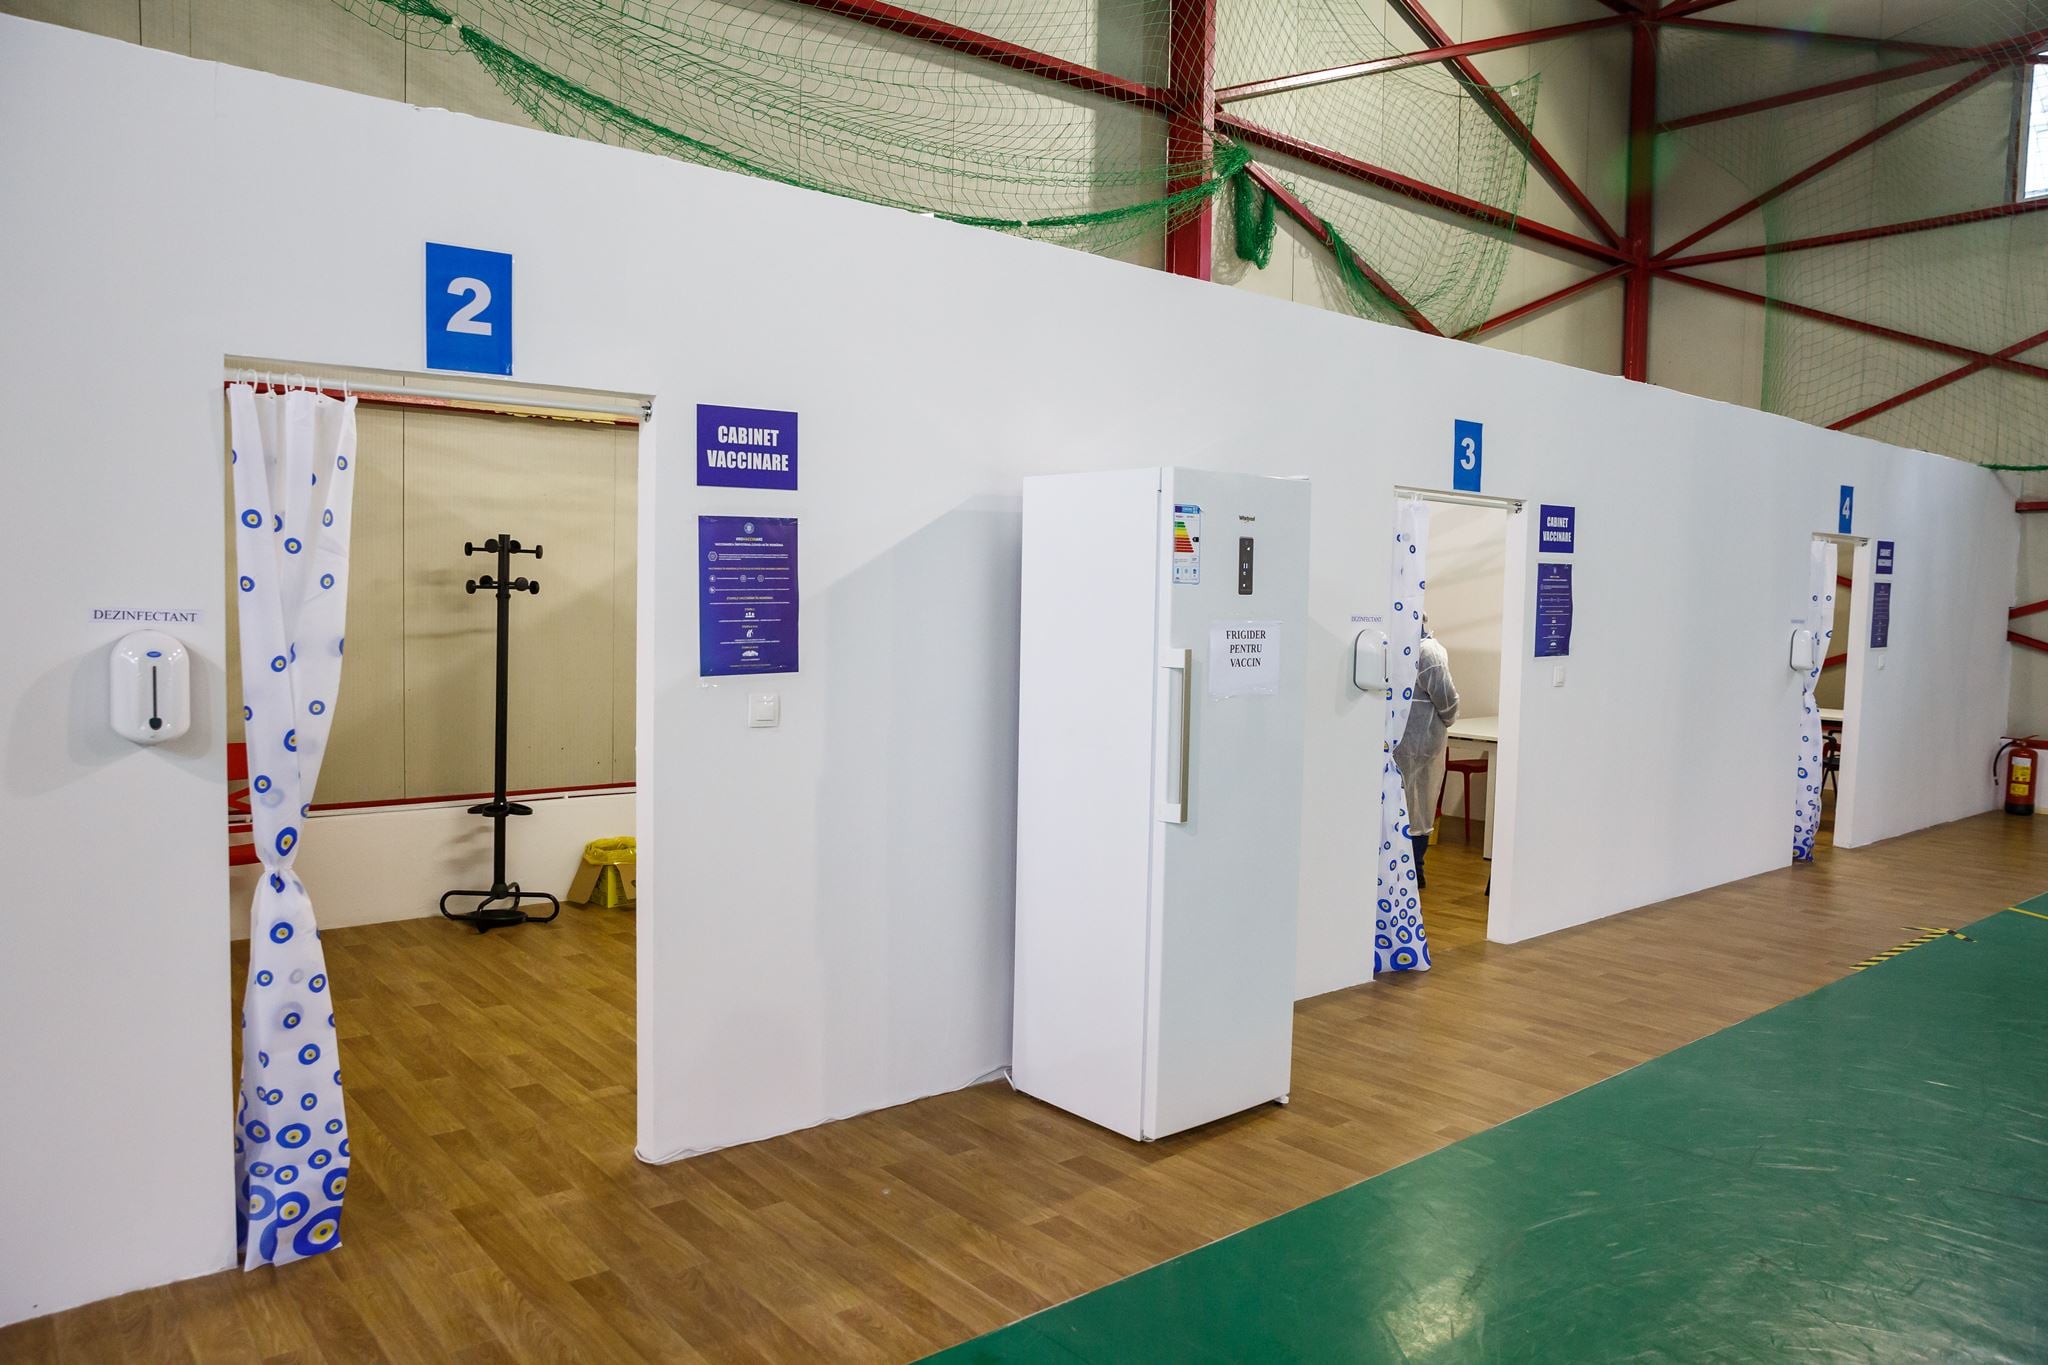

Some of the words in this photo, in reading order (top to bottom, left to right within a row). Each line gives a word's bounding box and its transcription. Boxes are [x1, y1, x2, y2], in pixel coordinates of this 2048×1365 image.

[446, 276, 492, 336] 2
[717, 425, 779, 447] CABINET
[706, 449, 789, 471] VACCINARE
[1460, 437, 1476, 470] 3
[1842, 497, 1850, 519] 4
[1547, 516, 1568, 528] CABINET
[93, 609, 198, 622] DEZINFECTANT
[1226, 630, 1266, 640] FRIGIDER
[1229, 644, 1262, 653] PENTRU
[1230, 658, 1262, 667] VACCIN
